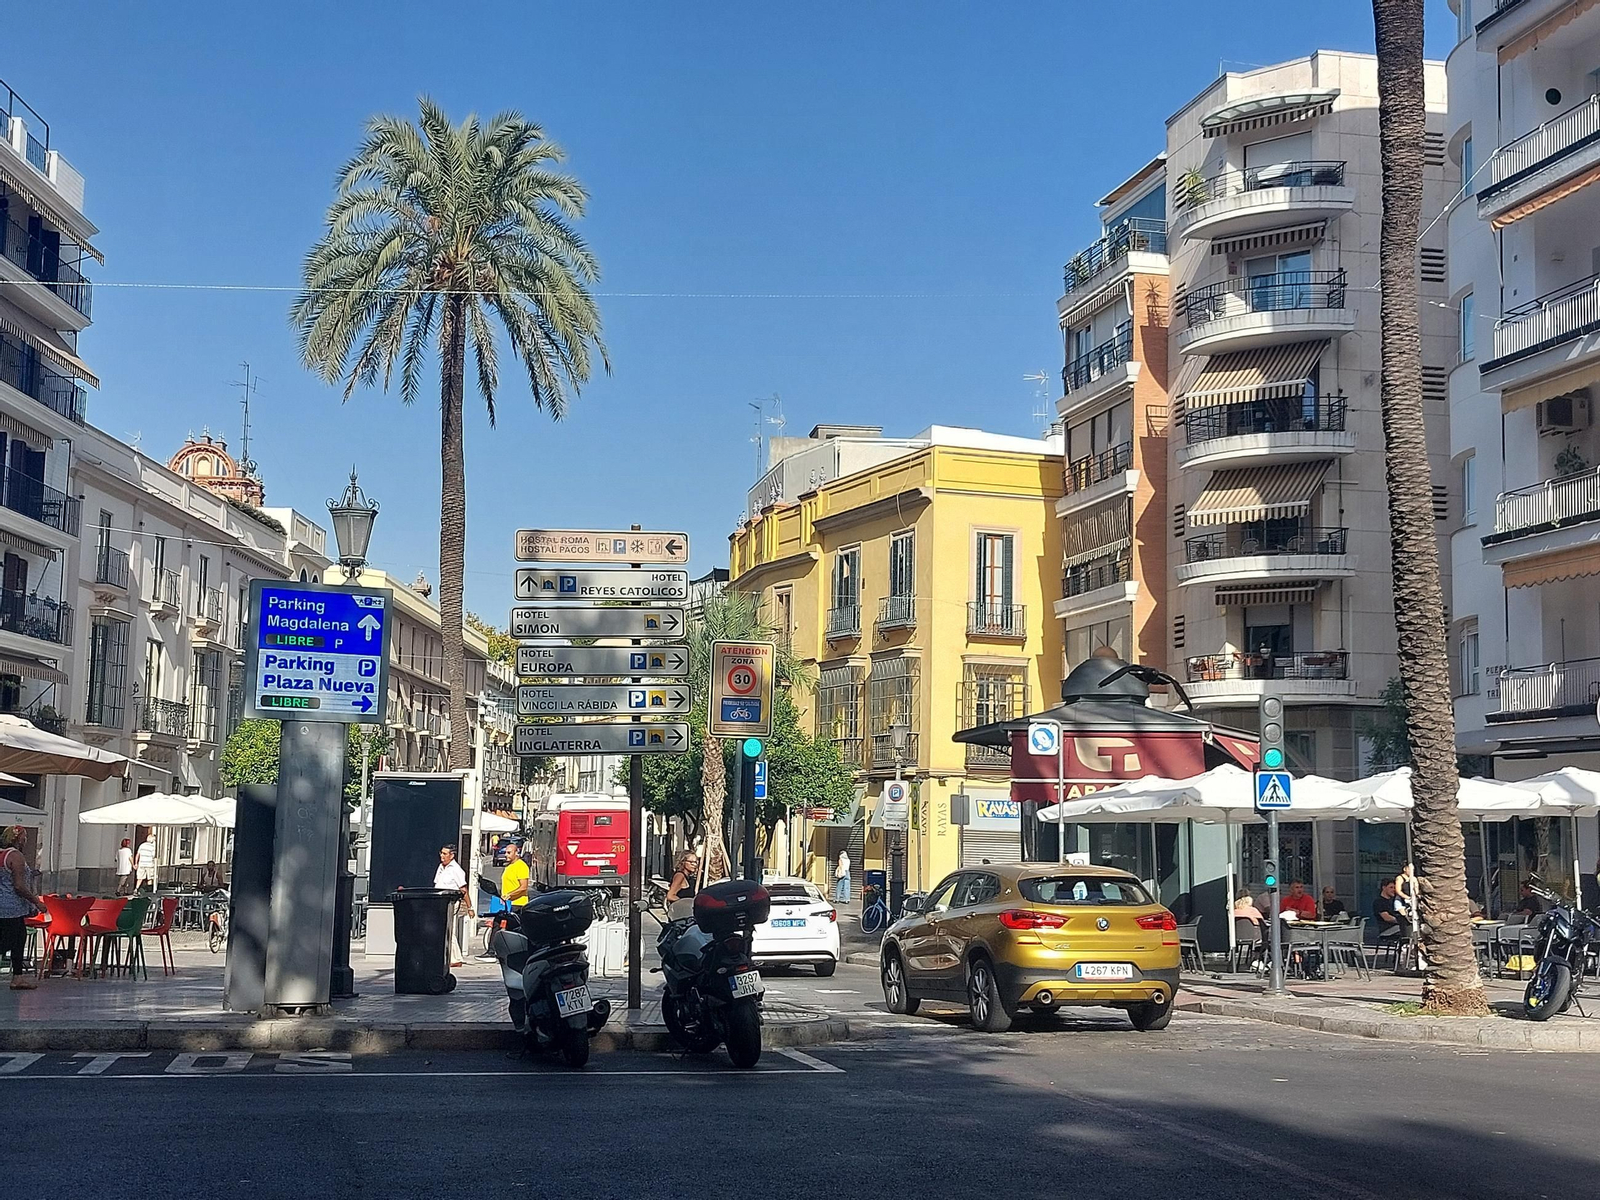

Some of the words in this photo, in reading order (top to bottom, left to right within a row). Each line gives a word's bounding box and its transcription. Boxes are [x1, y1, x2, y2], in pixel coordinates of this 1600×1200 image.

[521, 536, 558, 544] HOSTAL
[561, 536, 590, 544] ROMA
[521, 546, 557, 554] HOSTAL
[560, 546, 590, 554] PACOS
[652, 574, 683, 582] HOTEL
[580, 587, 616, 595] REYES
[620, 587, 683, 596] CATOLICOS
[269, 596, 325, 614] Parking
[516, 611, 549, 619] HOTEL
[267, 614, 349, 631] Magdalena
[516, 624, 560, 634] SIMON
[276, 635, 314, 646] LIBRE
[335, 639, 343, 649] P
[521, 650, 554, 658] HOTEL
[265, 654, 335, 675] Parking
[731, 657, 755, 665] ZONA
[521, 663, 574, 673] EUROPA
[263, 675, 314, 690] Plaza
[319, 677, 375, 693] Nueva
[734, 674, 751, 685] 30
[521, 690, 554, 698] HOTEL
[272, 697, 309, 708] LIBRE
[522, 701, 558, 710] VINCCI
[560, 701, 575, 710] LA
[577, 699, 618, 710] RÁBIDA
[520, 728, 552, 736] HOTEL
[519, 740, 602, 751] INGLATERRA
[977, 801, 1019, 817] RAYAS
[937, 802, 947, 836] RAYAS
[611, 845, 626, 853] 219
[1085, 965, 1108, 975] 4267
[1110, 965, 1129, 975] KPN
[736, 972, 758, 986] 3297
[563, 987, 587, 1001] 7282
